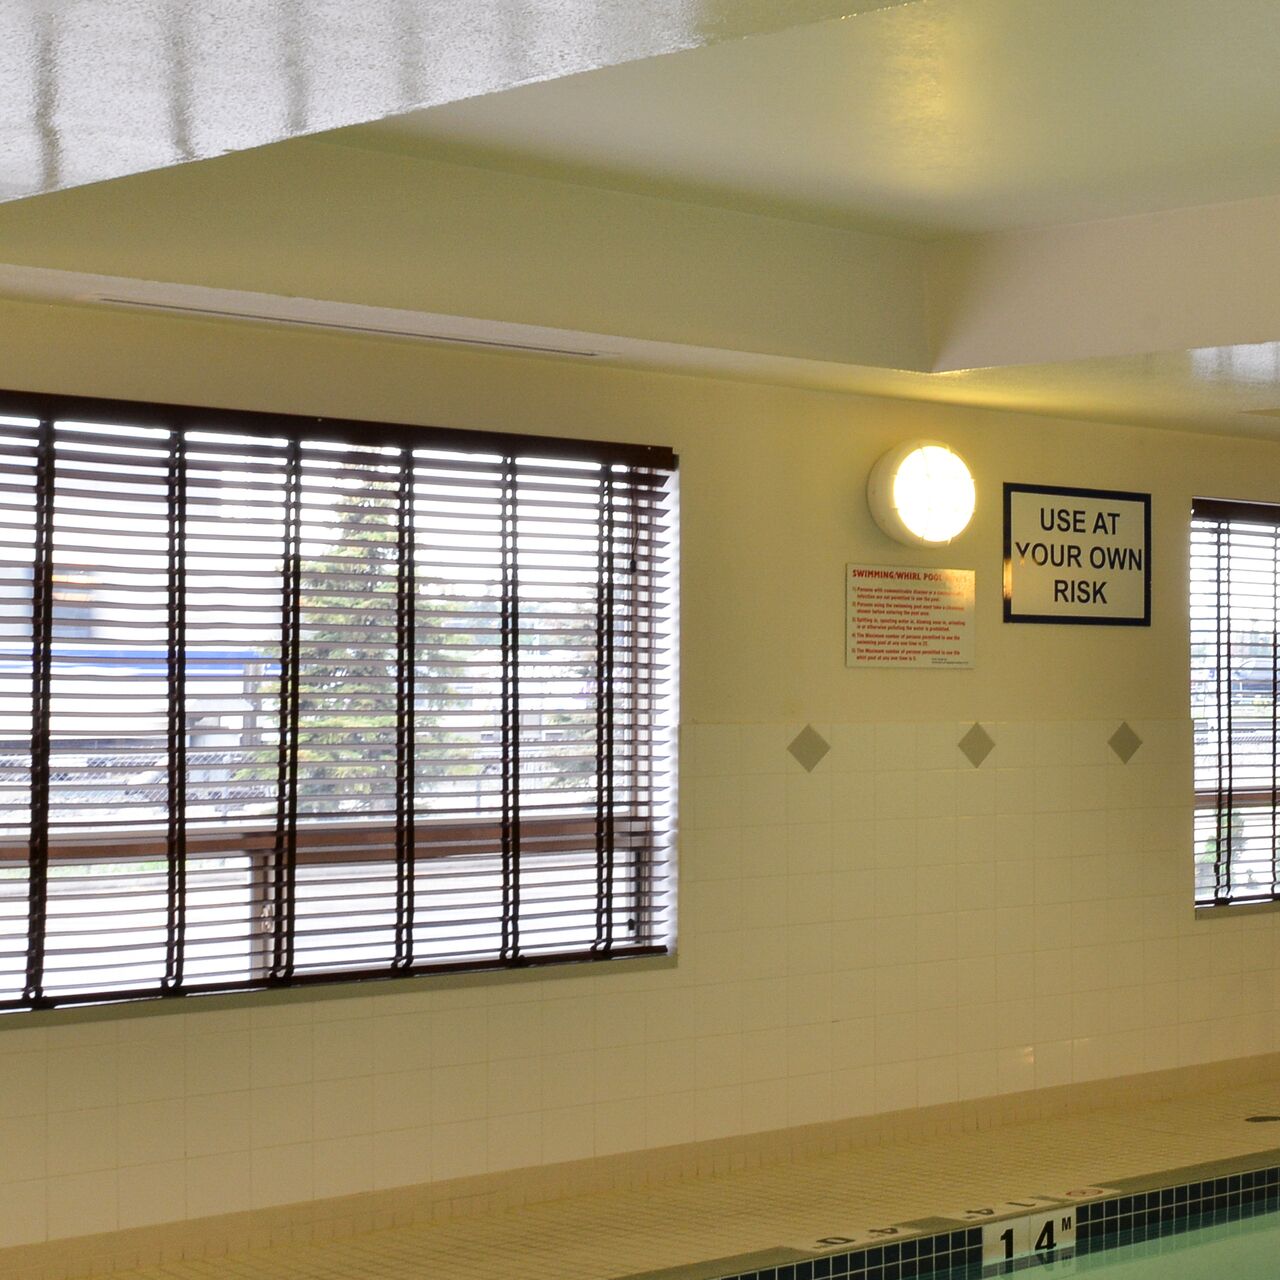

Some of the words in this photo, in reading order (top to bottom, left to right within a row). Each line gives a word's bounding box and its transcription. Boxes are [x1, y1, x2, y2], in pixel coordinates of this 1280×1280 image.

[1040, 507, 1086, 534] USE
[1092, 512, 1121, 535] AT
[1015, 542, 1082, 568] YOUR
[1089, 546, 1143, 571] OWN
[1054, 579, 1108, 604] RISK
